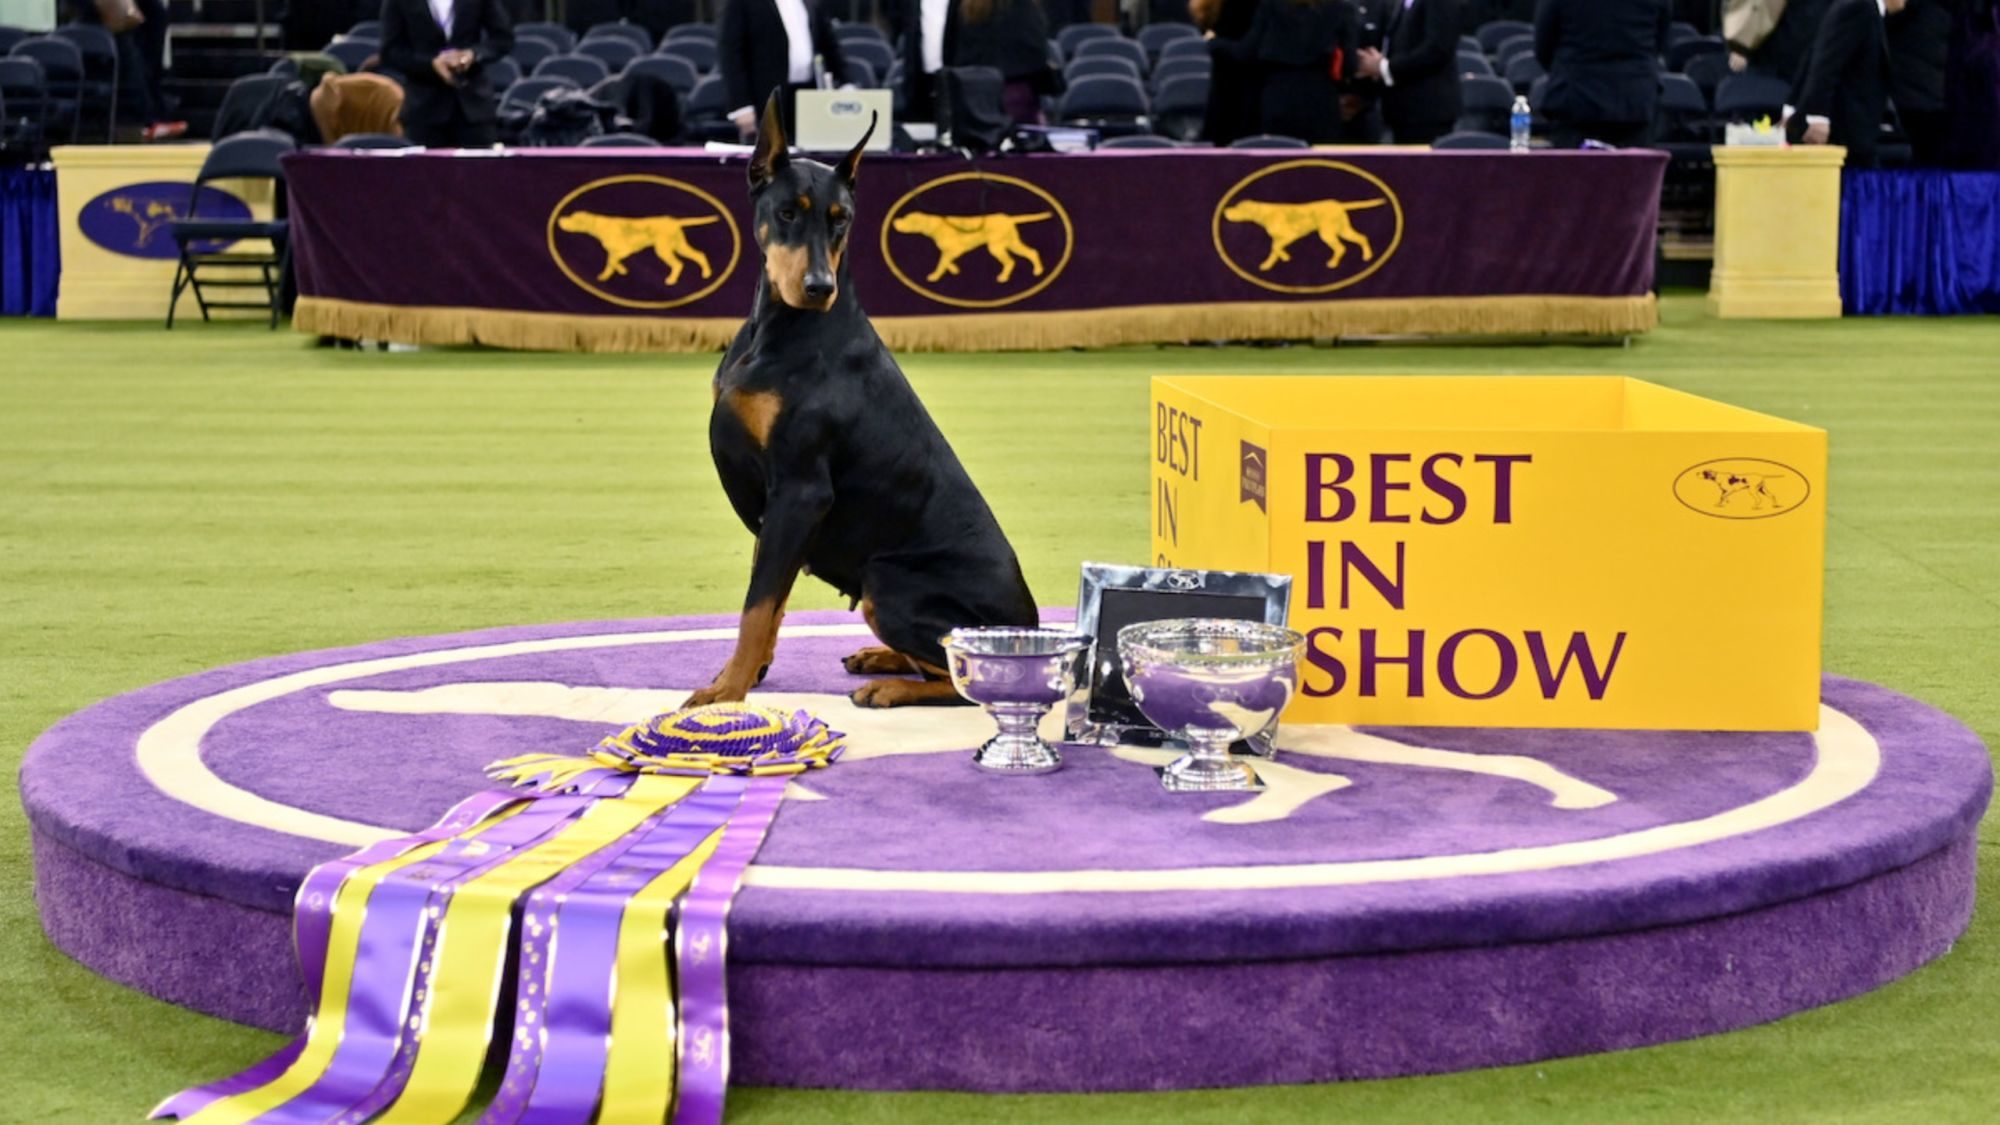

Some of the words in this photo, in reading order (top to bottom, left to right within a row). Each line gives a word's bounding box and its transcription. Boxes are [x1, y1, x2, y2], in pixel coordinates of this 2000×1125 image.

[1157, 402, 1202, 482] BEST
[1158, 477, 1178, 549] IN
[1304, 452, 1532, 525] BEST
[1307, 541, 1405, 610] IN
[1302, 627, 1627, 700] SHOW
